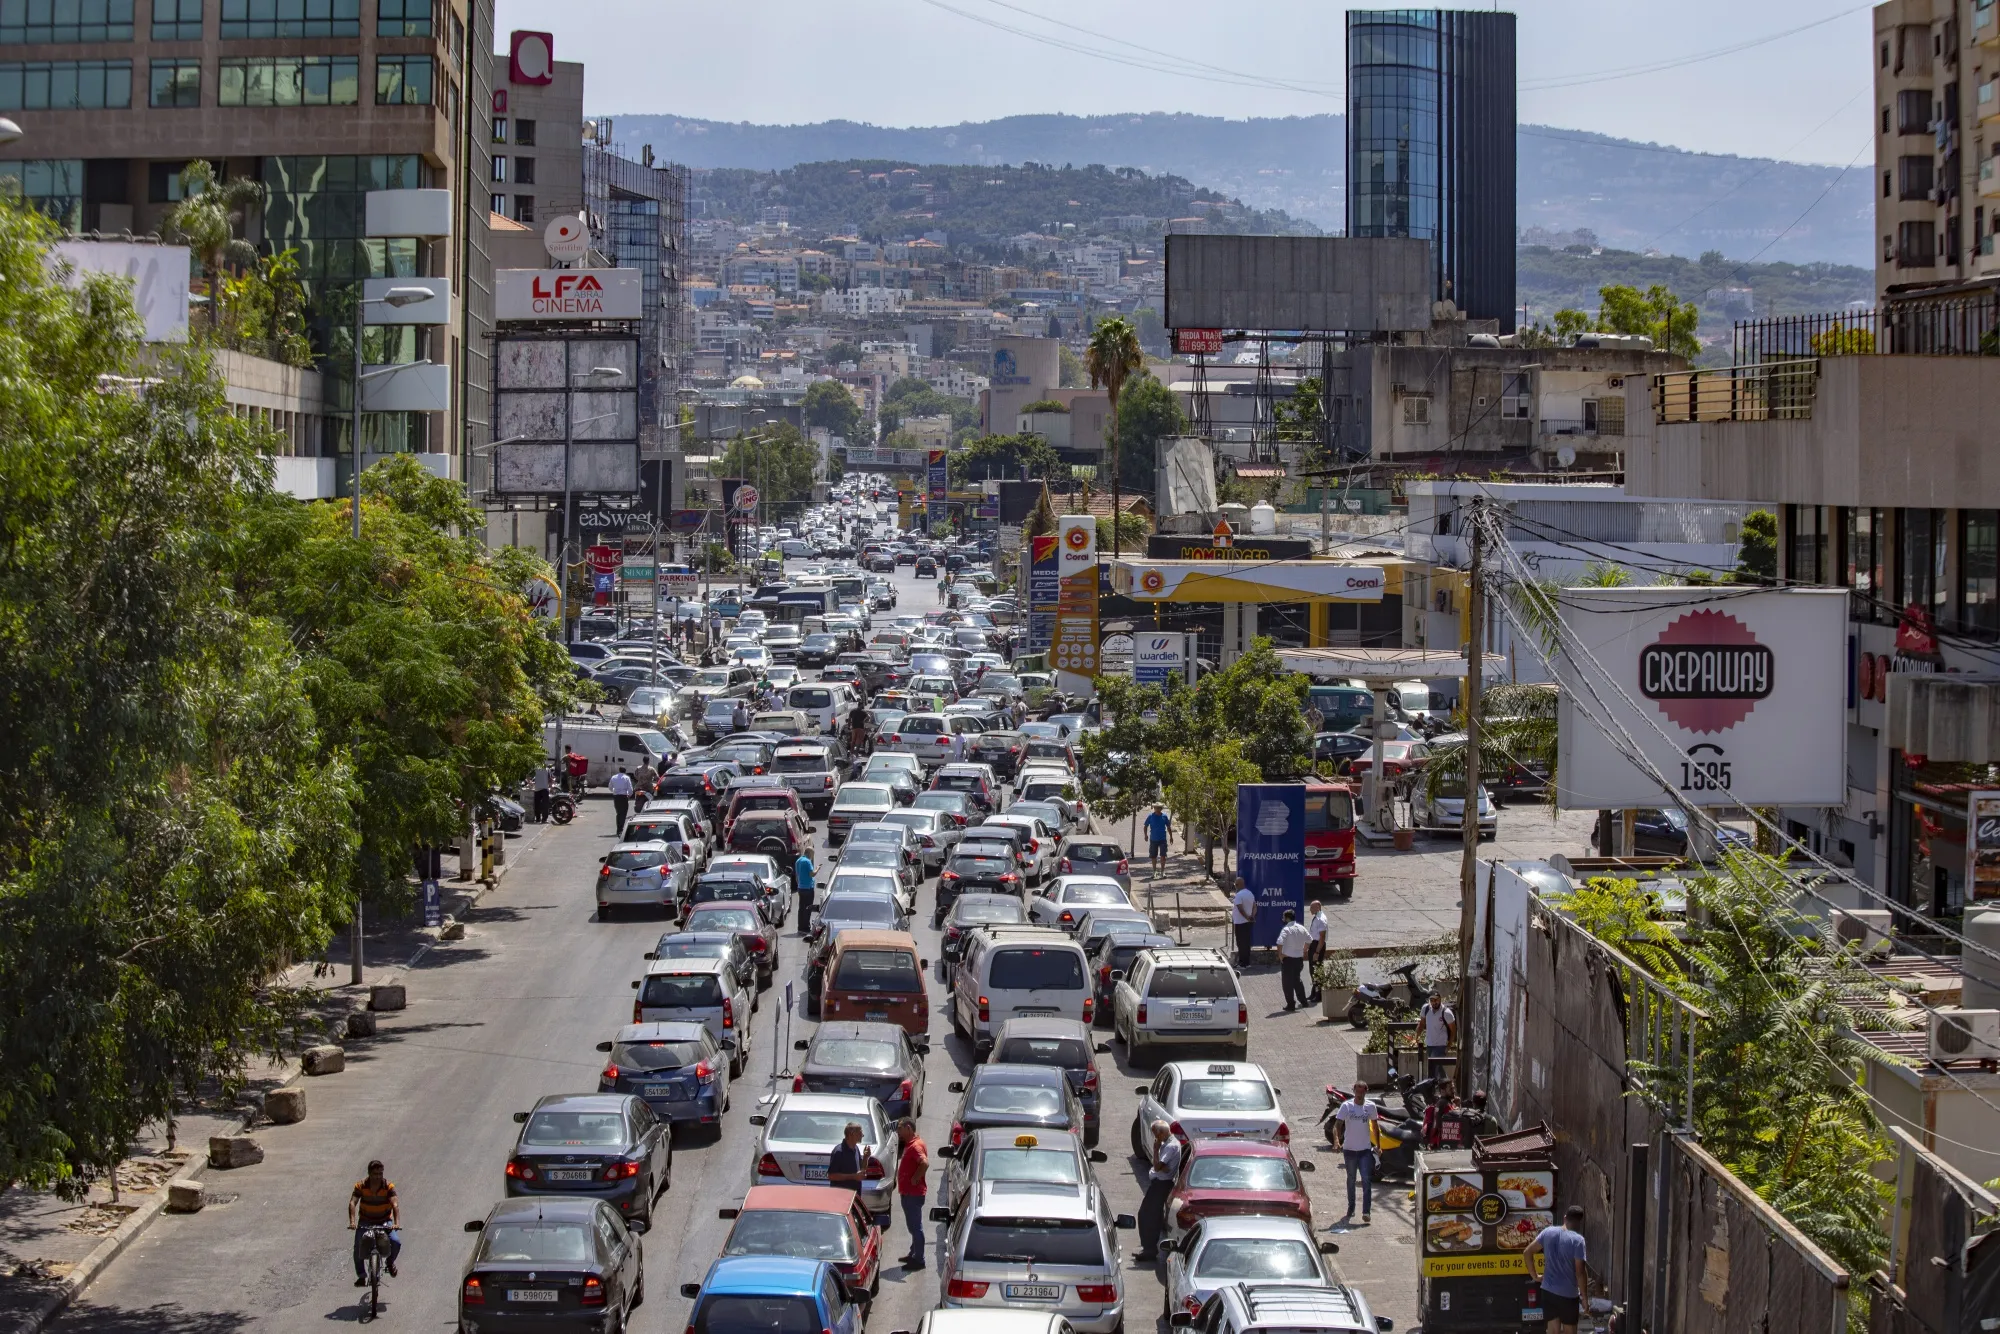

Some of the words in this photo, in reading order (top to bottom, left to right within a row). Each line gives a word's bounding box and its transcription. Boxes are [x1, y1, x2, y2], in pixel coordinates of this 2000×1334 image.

[574, 290, 604, 298] ABRAJ
[532, 299, 603, 313] CINEMA
[1180, 331, 1199, 340] MEDIA
[1191, 341, 1206, 351] 695
[1065, 553, 1089, 561] Coral
[1346, 577, 1379, 588] Coral
[1140, 651, 1178, 660] wardieh
[1645, 651, 1768, 693] CREPAWAY
[1681, 762, 1732, 791] 1595
[1243, 852, 1299, 860] FRANSABANK
[1261, 887, 1283, 897] ATM
[1272, 900, 1297, 908] Banking
[1019, 1137, 1036, 1145] TAXI
[1430, 1262, 1444, 1271] For
[1446, 1262, 1464, 1272] your
[1467, 1260, 1497, 1269] events:
[1500, 1259, 1510, 1268] 03
[1512, 1259, 1523, 1267] 42
[523, 1290, 553, 1300] 598025
[1023, 1286, 1053, 1296] 231964
